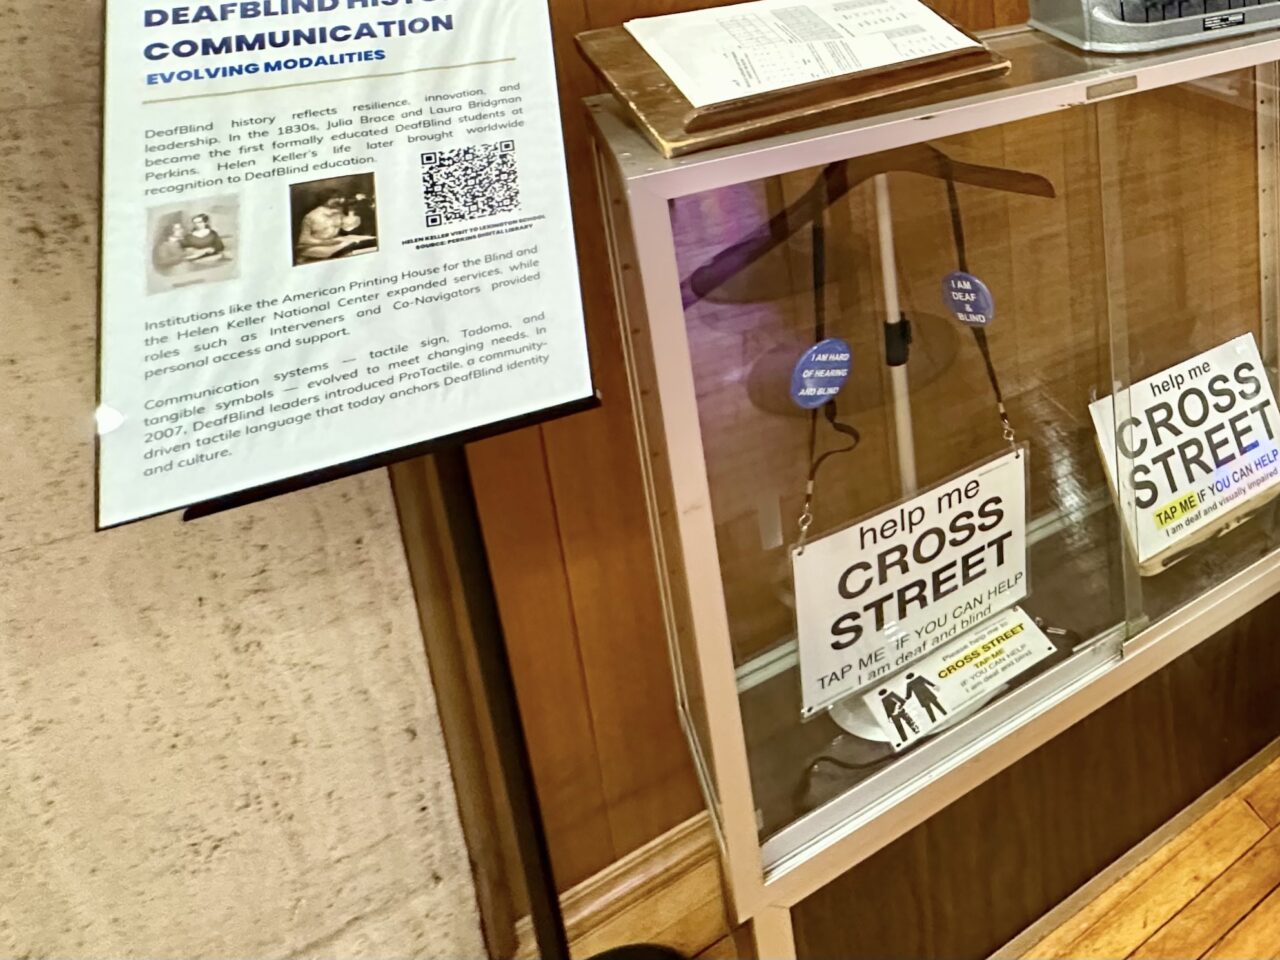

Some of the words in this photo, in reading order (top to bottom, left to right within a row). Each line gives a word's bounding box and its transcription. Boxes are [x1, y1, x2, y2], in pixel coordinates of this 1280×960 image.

[143, 14, 454, 60] COMMUNICATION
[146, 62, 260, 85] EVOLVING
[263, 49, 386, 73] MODALITIES
[144, 121, 214, 139] DeafBlind
[231, 116, 276, 128] history
[292, 107, 338, 119] reflects
[499, 82, 521, 92] and
[228, 133, 241, 142] In
[247, 130, 269, 138] the
[326, 118, 353, 130] Julia
[360, 114, 395, 124] Brace
[401, 107, 423, 118] and
[429, 104, 462, 114] Laura
[468, 96, 522, 109] Bridgman
[144, 153, 200, 167] became
[208, 148, 231, 158] the
[238, 143, 264, 154] first
[271, 135, 324, 149] formally
[330, 126, 389, 140] educated
[395, 117, 452, 132] DeafBlind
[458, 110, 506, 123] students
[511, 107, 523, 121] at
[951, 280, 955, 288] I
[957, 280, 972, 289] AM
[951, 292, 976, 301] DEAF
[965, 304, 973, 312] &
[956, 312, 986, 323] BLIND
[798, 387, 816, 396] AND
[817, 387, 839, 395] BLIND
[802, 369, 814, 378] OF
[815, 369, 848, 377] HEARING
[1150, 374, 1185, 397] help
[1188, 362, 1211, 380] me
[1117, 362, 1261, 459] CROSS
[1130, 399, 1274, 509] STREET
[1156, 506, 1178, 525] TAP
[1179, 495, 1198, 514] ME
[1197, 490, 1206, 504] IF
[1208, 476, 1231, 496] YOU
[1232, 465, 1253, 483] CAN
[1254, 449, 1279, 471] HELP
[1171, 522, 1183, 534] am
[1185, 512, 1202, 527] deaf
[1203, 503, 1218, 517] and
[1218, 486, 1247, 507] visually
[860, 505, 925, 550] help
[938, 479, 980, 513] me
[838, 496, 1004, 600] CROSS
[830, 530, 1012, 651] STREET
[817, 665, 853, 690] TAP
[859, 647, 886, 671] ME
[895, 635, 910, 651] IF
[914, 614, 948, 638] YOU
[952, 594, 983, 619] CAN
[988, 572, 1023, 600] HELP
[858, 675, 862, 685] I
[867, 663, 890, 681] am
[896, 641, 927, 666] deaf
[931, 627, 956, 646] and
[961, 604, 992, 629] blind
[938, 650, 981, 678] CROSS
[982, 623, 1025, 652] STREET
[974, 656, 990, 669] TAP
[992, 649, 1004, 659] ME
